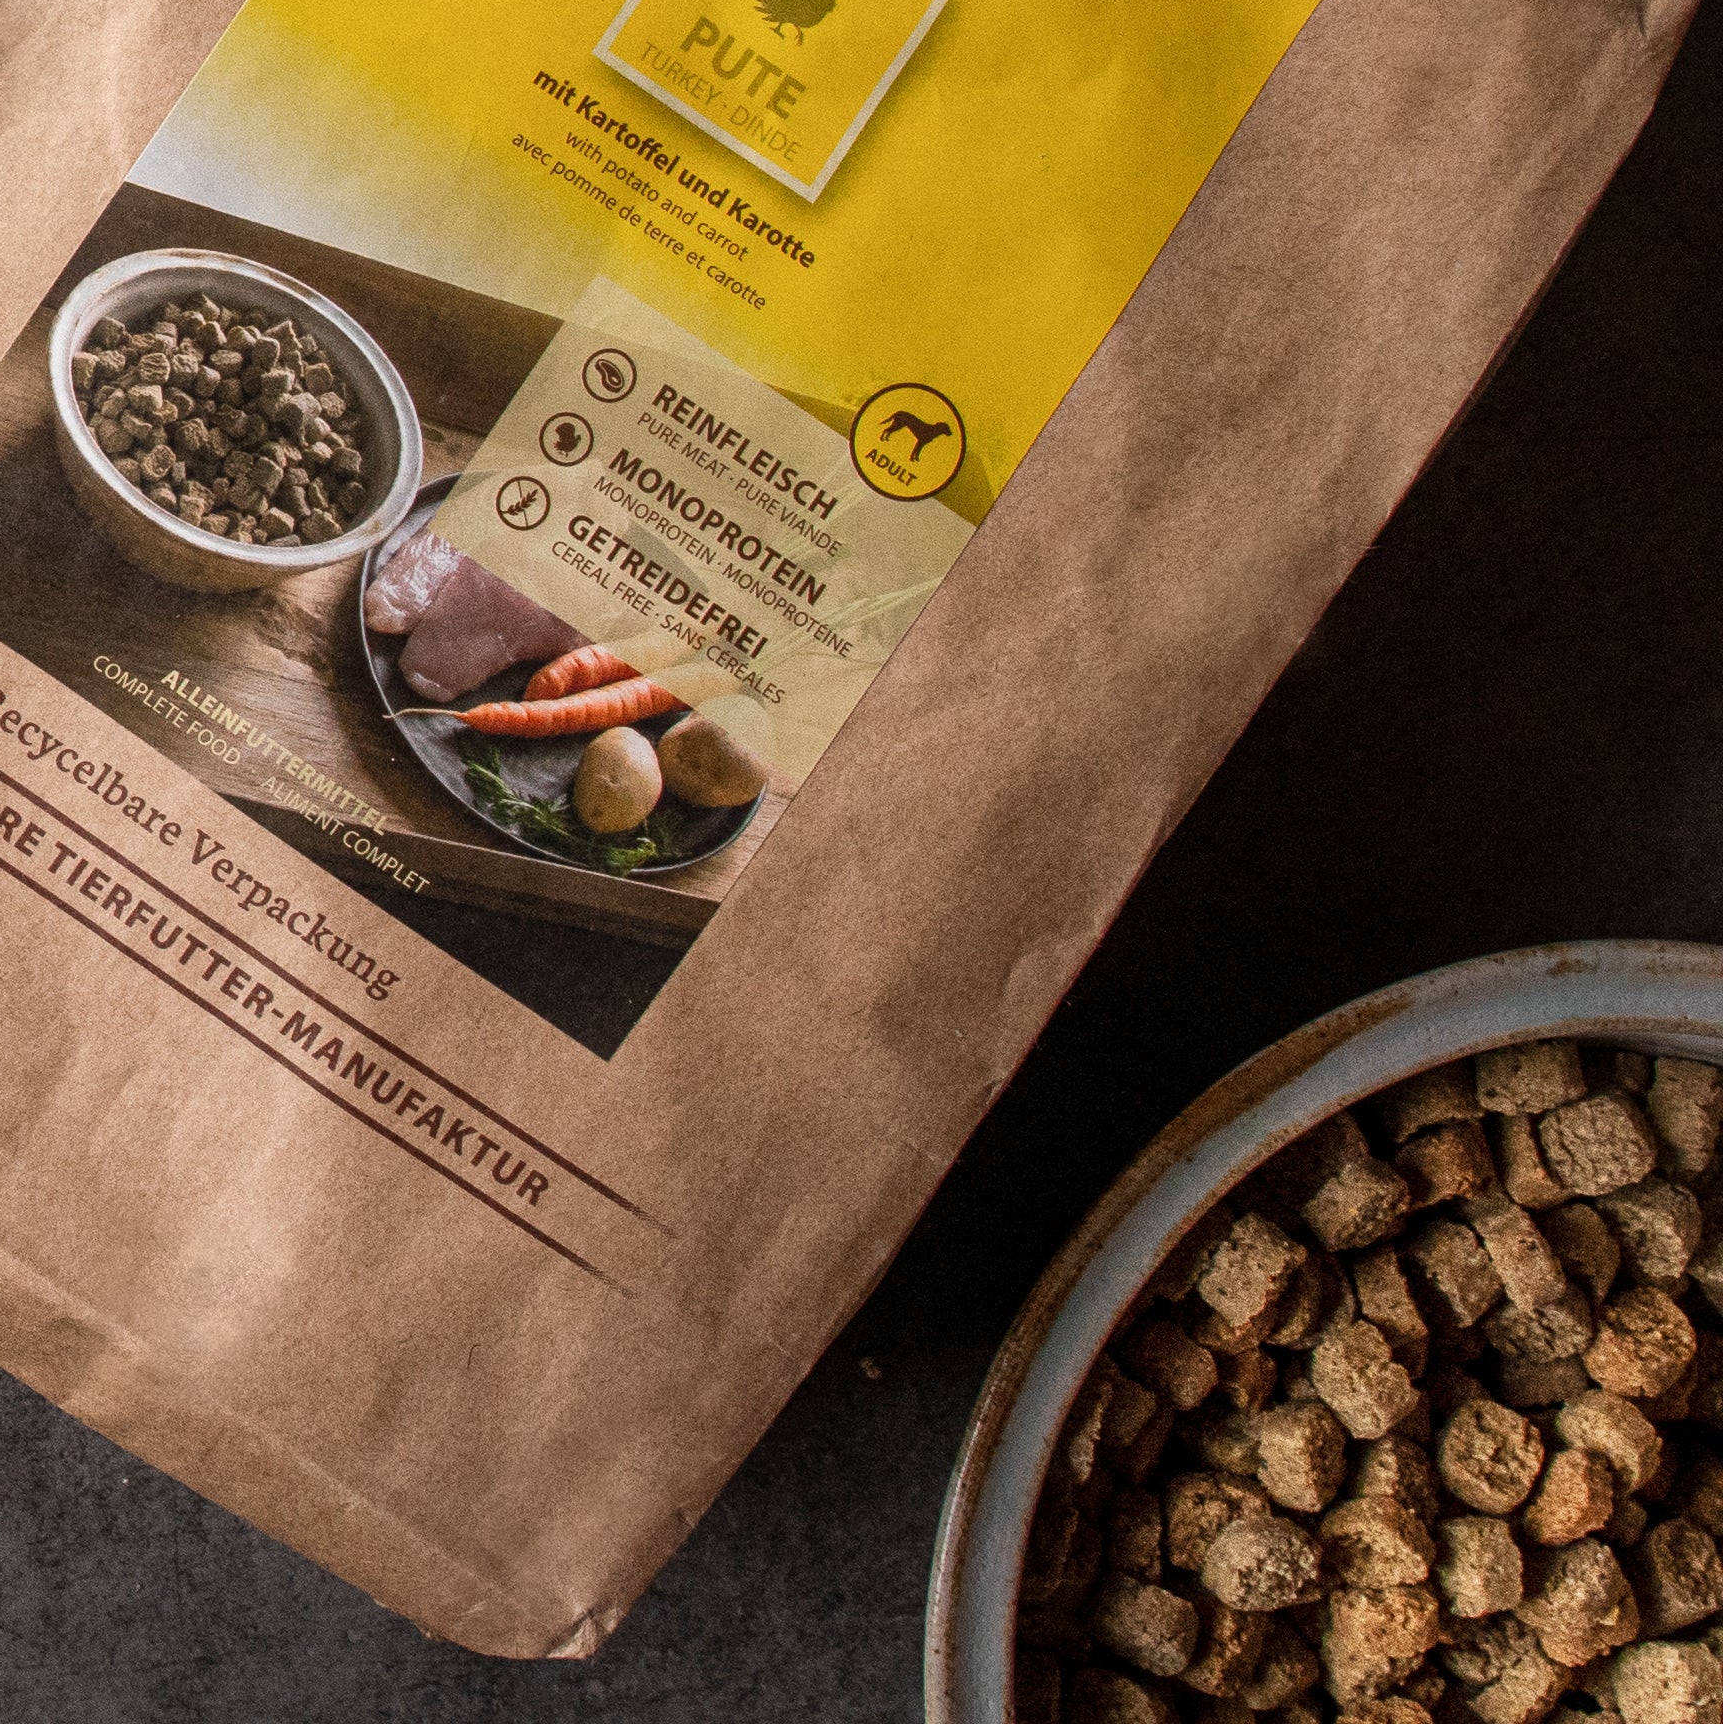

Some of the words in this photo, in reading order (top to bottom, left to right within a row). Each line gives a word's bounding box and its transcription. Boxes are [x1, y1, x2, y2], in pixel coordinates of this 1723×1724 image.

[639, 41, 721, 105] TURKEY
[730, 105, 802, 162] DINDE
[679, 15, 807, 120] PUTE
[511, 132, 551, 166] avec
[550, 158, 617, 212] pomme
[617, 204, 642, 227] de
[643, 220, 685, 256] terre
[685, 249, 705, 271] et
[706, 262, 767, 310] carotte
[533, 70, 576, 107] mit
[575, 94, 682, 175] Kartoffel
[677, 163, 729, 208] und
[727, 197, 816, 269] Karotte
[565, 130, 602, 164] with
[602, 154, 659, 203] potato
[660, 197, 696, 226] and
[696, 219, 749, 262] carrot
[608, 448, 827, 607] MONOPROTEIN
[637, 412, 682, 450] PURE
[680, 440, 728, 479] MEAT
[734, 478, 781, 515] PURE
[777, 505, 842, 558] VIANDE
[651, 383, 838, 521] REINFLEISCH
[865, 447, 918, 487] ADULT
[551, 540, 611, 590] CEREAL
[613, 582, 655, 618] FREE
[659, 613, 706, 652] SANS
[706, 645, 786, 705] CÉRÉALES
[566, 514, 769, 661] GETREIDEFREI
[593, 476, 715, 566] MONOPROTEIN
[723, 565, 854, 659] MONOPROTÉINE
[93, 654, 187, 730] COMPLETE
[184, 719, 243, 767] FOOD
[261, 776, 345, 838] ALIMENT
[341, 829, 431, 896] COMPLET
[161, 669, 393, 837] ALLEINFUTTERMITTEL
[185, 828, 402, 1003] Verpackung
[45, 841, 556, 1207] TIERFUTTER-MANUFAKTUR
